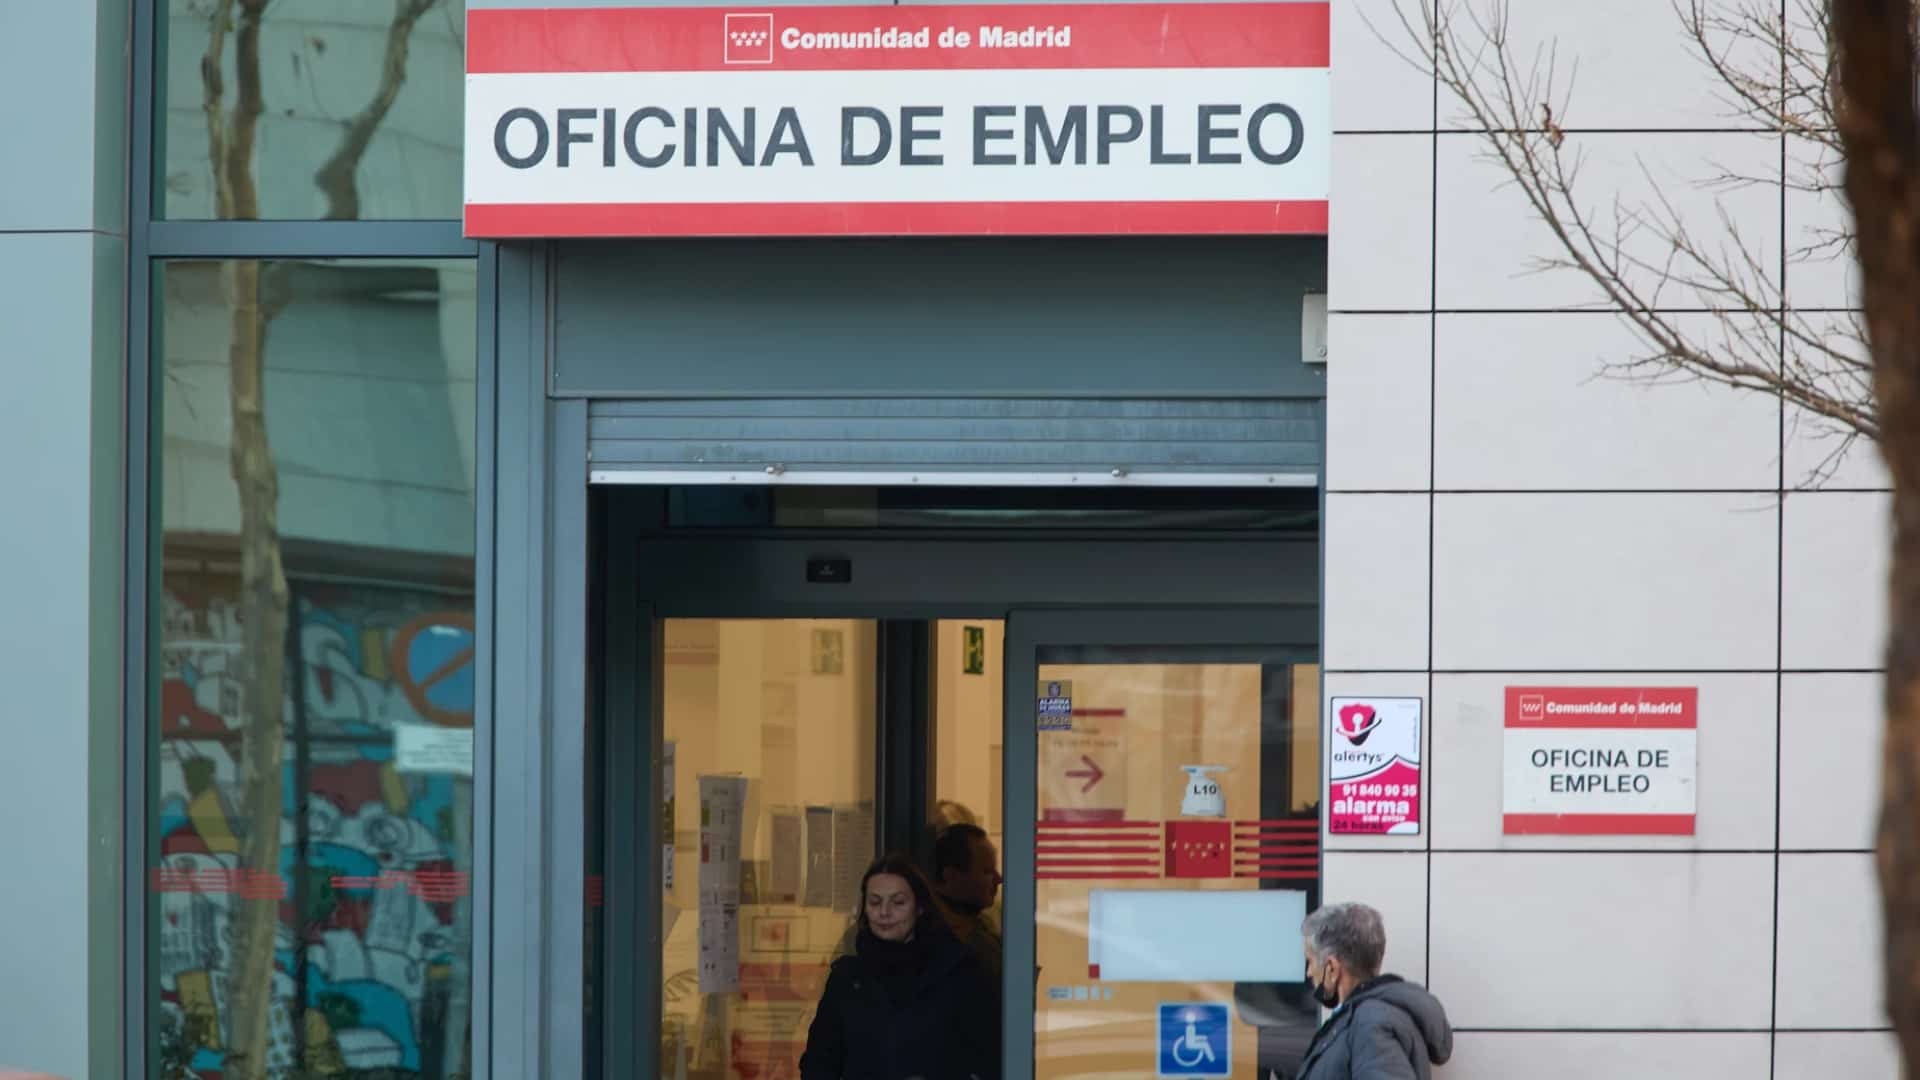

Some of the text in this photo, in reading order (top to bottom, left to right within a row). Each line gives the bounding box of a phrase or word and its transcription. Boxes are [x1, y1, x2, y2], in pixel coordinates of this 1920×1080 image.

[780, 26, 1071, 49] Comunidad de Madrid
[494, 103, 1304, 169] OFICINA DE EMPLEO
[1546, 702, 1682, 714] Comunidad de Madrid
[1531, 749, 1669, 768] OFICINA DE
[1193, 784, 1217, 795] L10
[1343, 784, 1357, 797] 91
[1359, 784, 1382, 797] 840
[1384, 784, 1400, 797] 90
[1550, 774, 1650, 793] EMPLEO
[1333, 796, 1410, 815] alarma
